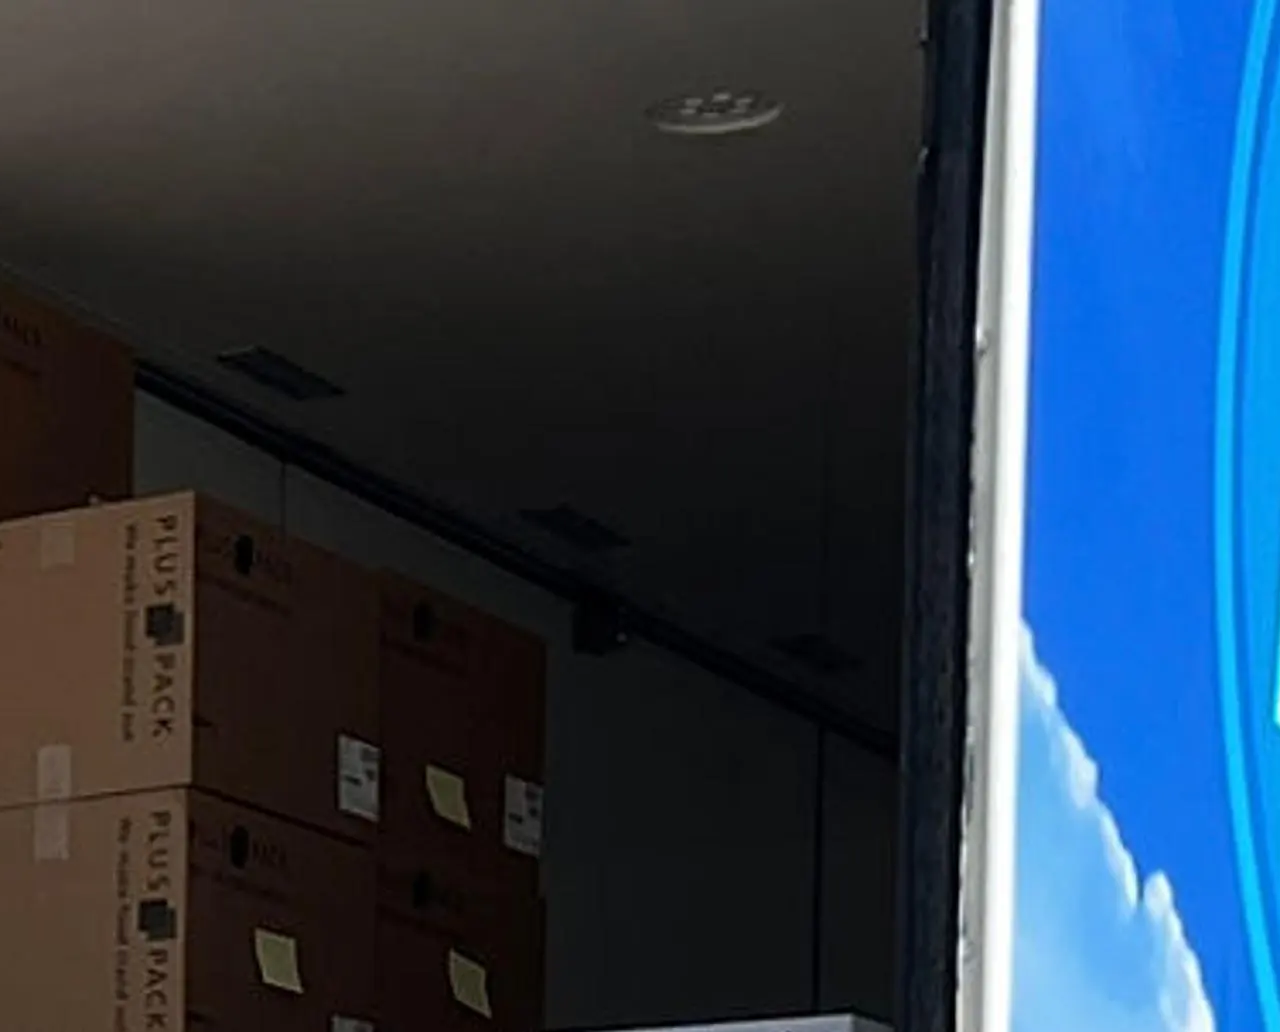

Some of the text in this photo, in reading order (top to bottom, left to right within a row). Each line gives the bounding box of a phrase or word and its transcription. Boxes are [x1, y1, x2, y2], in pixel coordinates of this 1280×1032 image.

[152, 514, 178, 738] PLUS PACK
[146, 811, 171, 1029] PLUS PACK
